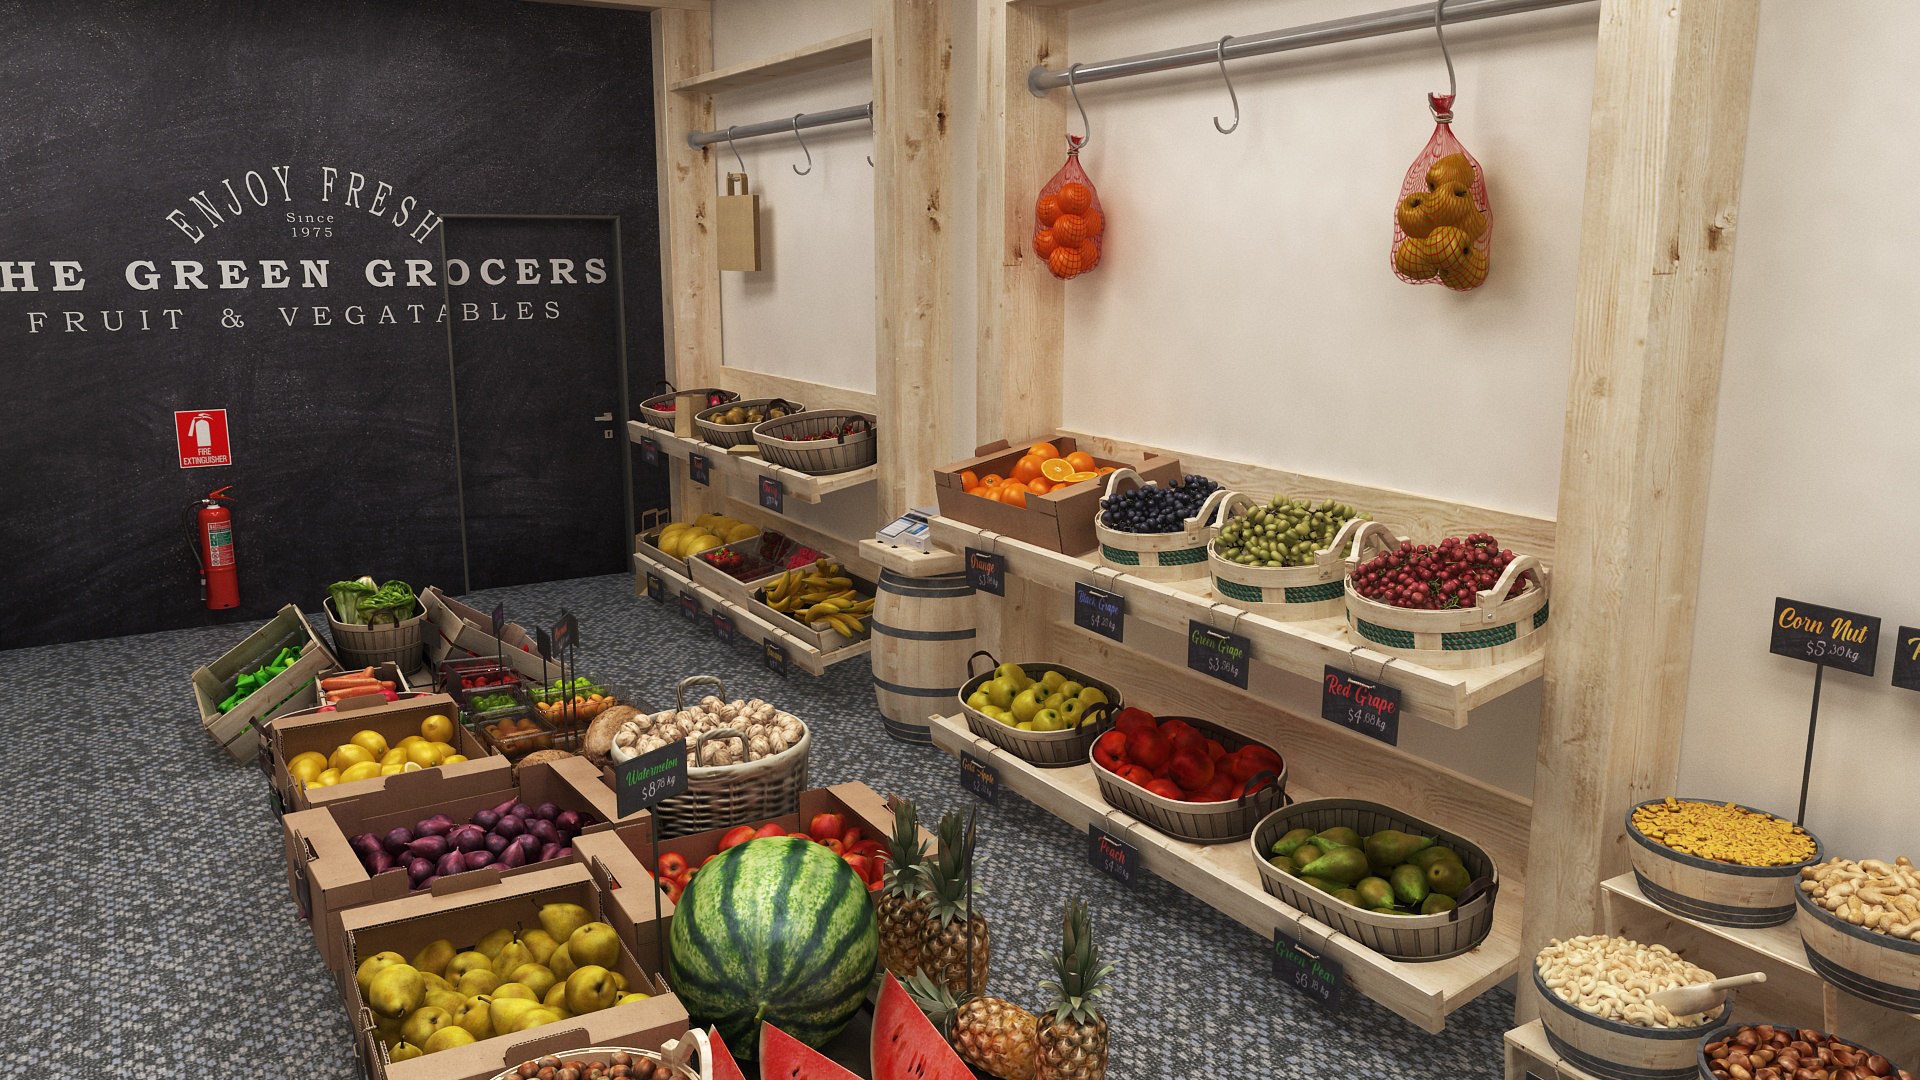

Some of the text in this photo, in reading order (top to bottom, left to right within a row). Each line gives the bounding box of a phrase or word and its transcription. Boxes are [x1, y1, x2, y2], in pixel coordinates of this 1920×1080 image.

[166, 166, 442, 244] ENJOY FRESH
[287, 213, 333, 223] Since
[292, 227, 332, 237] 1975
[126, 260, 329, 290] GREEN
[366, 259, 606, 287] GROCERS
[27, 302, 559, 332] FRUIT & VEGATABLES
[183, 455, 228, 466] EXTINGUISHER
[197, 448, 212, 456] FIRE
[1778, 607, 1869, 644] Corn Nut
[1191, 629, 1244, 660] Green Grape
[1325, 674, 1396, 715] Red Grape
[626, 757, 678, 787] Watermelon
[1275, 940, 1306, 968] Green
